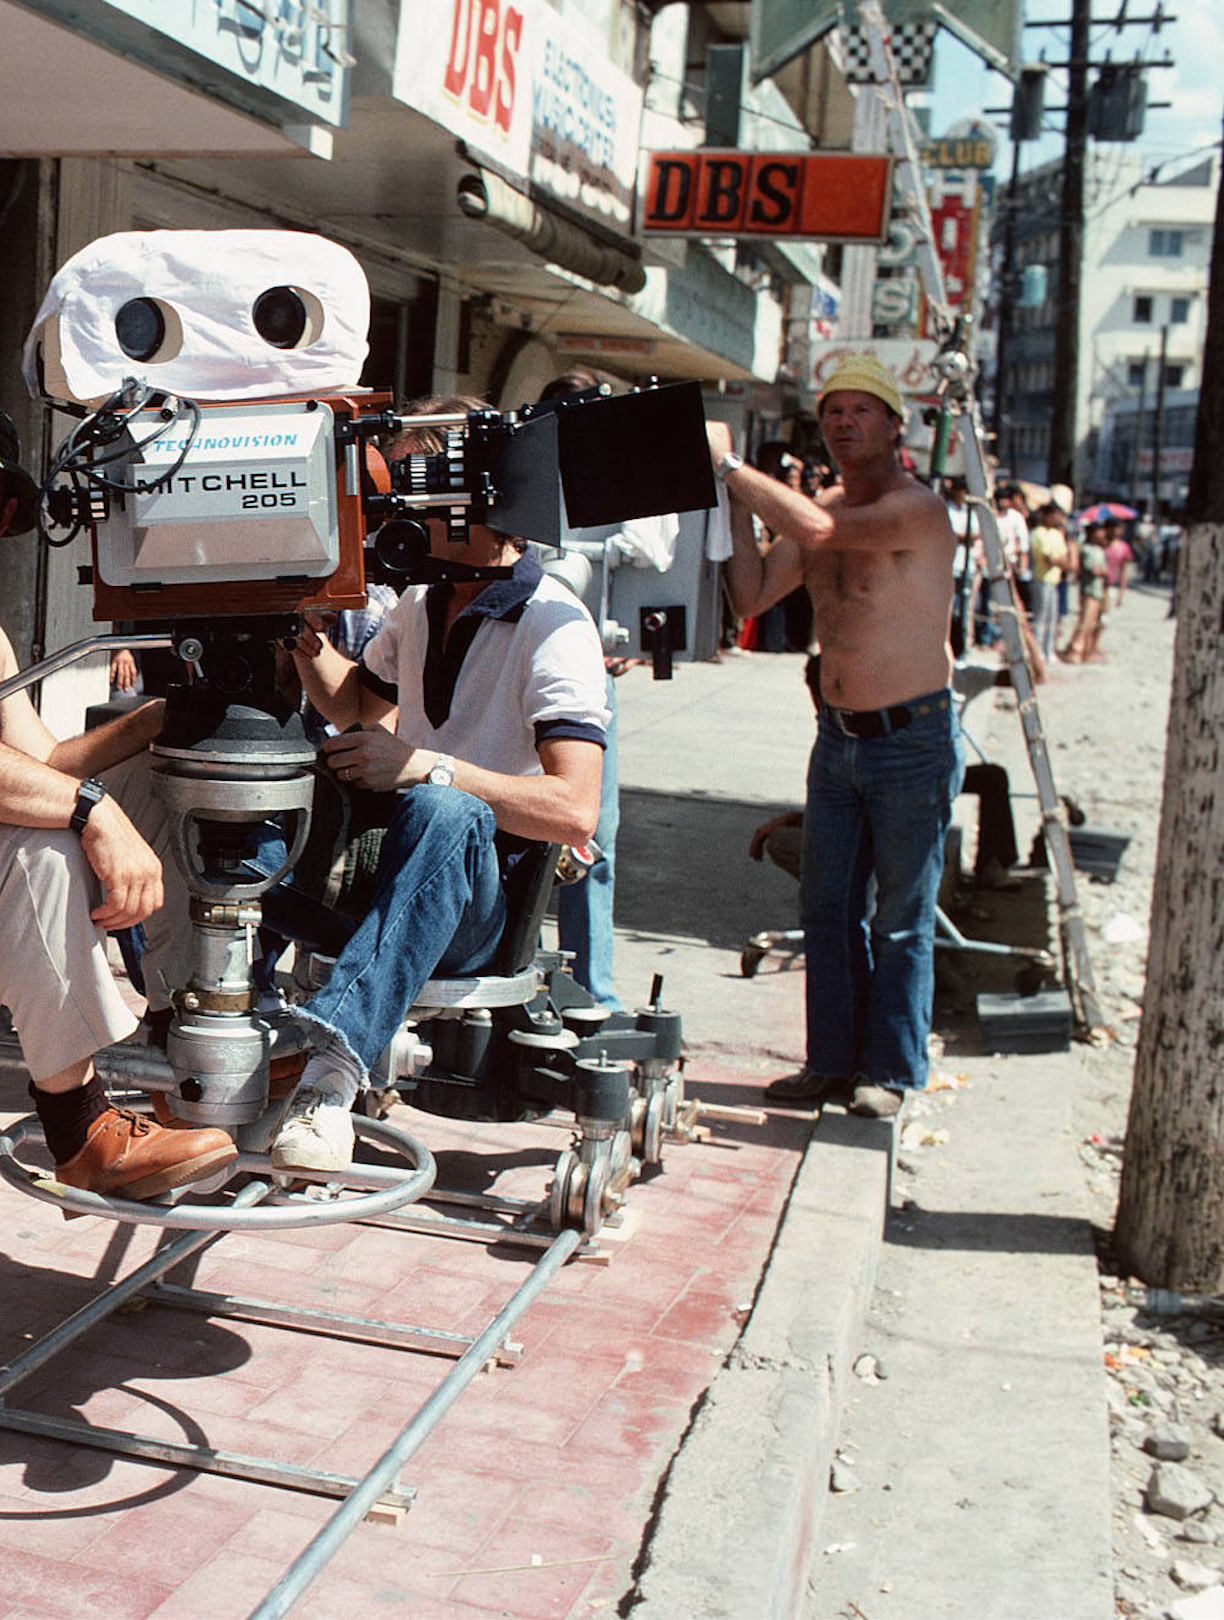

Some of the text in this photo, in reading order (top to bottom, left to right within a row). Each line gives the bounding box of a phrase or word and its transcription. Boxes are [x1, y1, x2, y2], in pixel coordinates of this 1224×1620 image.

[444, 0, 524, 133] DBS
[926, 139, 991, 168] CLUB
[648, 159, 798, 226] DBS
[154, 434, 298, 452] TECHNOVISION
[136, 472, 307, 495] MITCHELL
[242, 493, 296, 509] 205
